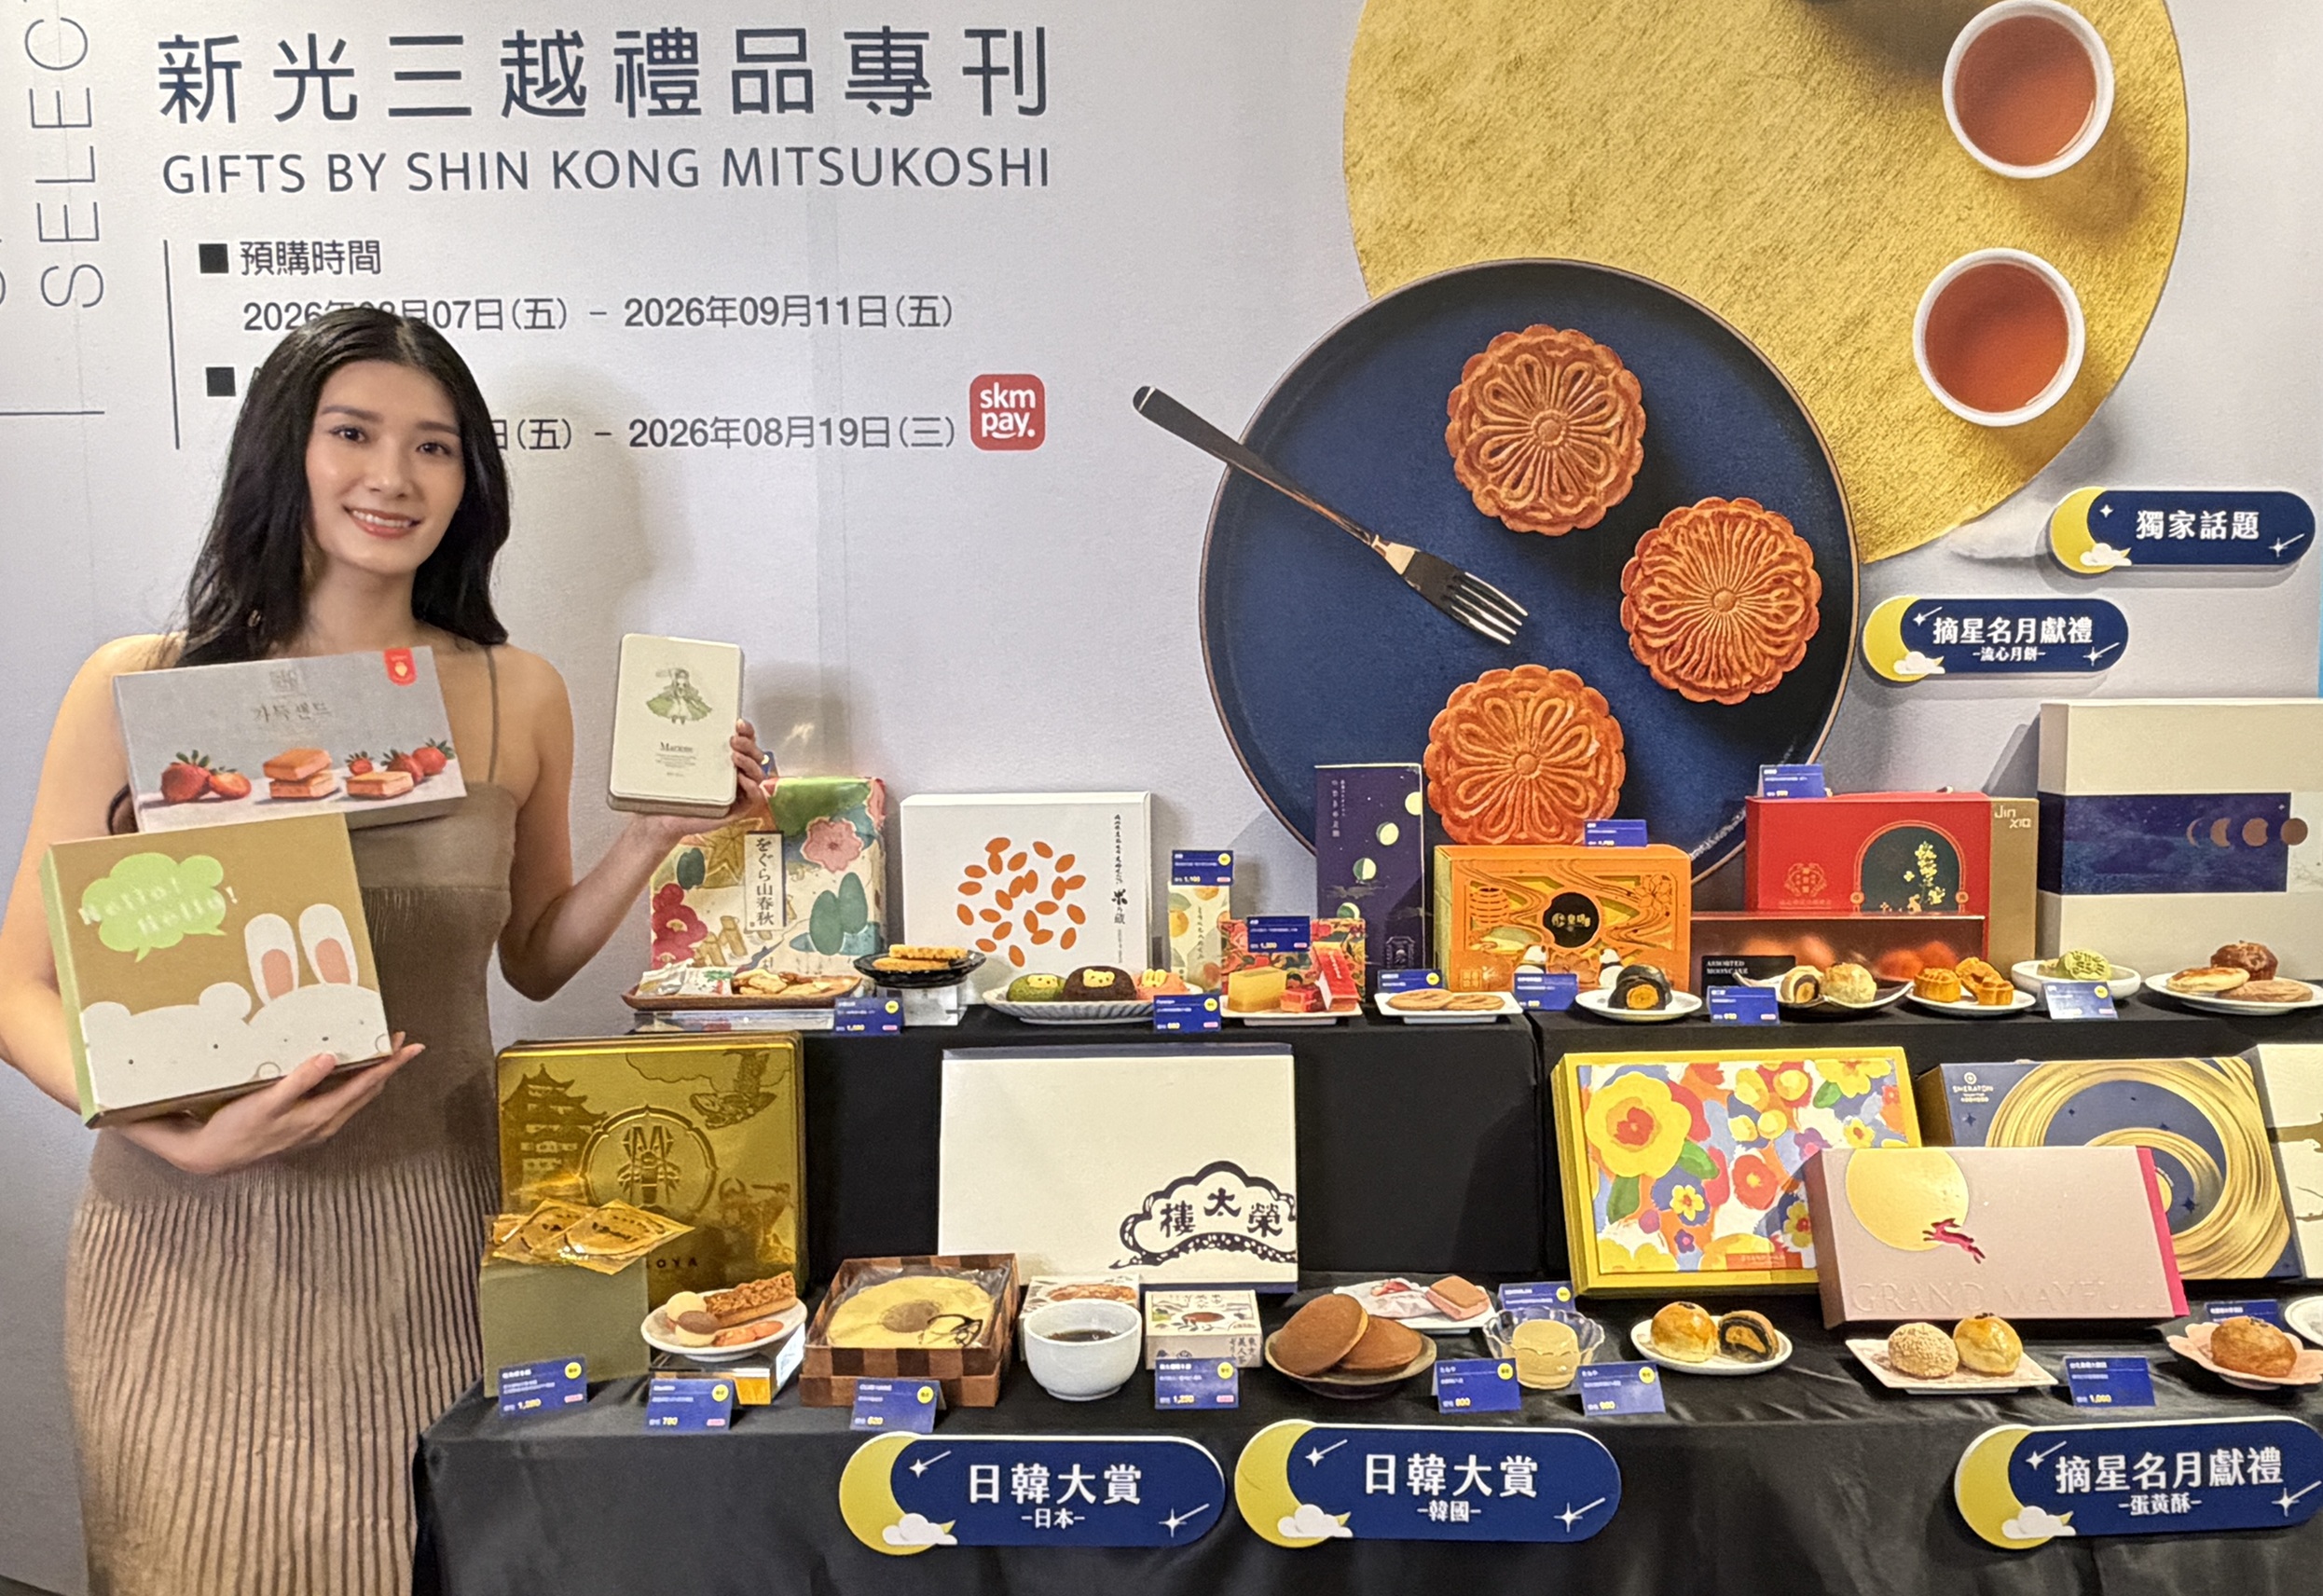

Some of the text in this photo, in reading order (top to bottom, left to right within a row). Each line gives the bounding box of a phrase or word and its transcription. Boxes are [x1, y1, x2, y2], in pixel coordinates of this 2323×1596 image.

[157, 25, 1048, 124] 新光三越禮品專刊
[23, 0, 104, 309] SELEC
[162, 145, 1049, 194] GIFTS BY SHIN KONG MITSUKOSHI
[239, 240, 382, 276] 預購時間
[978, 383, 1037, 410] skm
[981, 411, 1037, 439] pay.
[2136, 509, 2261, 541] 獨家話題
[1932, 615, 2094, 645] 摘星名月獻禮
[755, 836, 776, 927] をぐら山春秋
[646, 1256, 698, 1270] OYA
[1851, 1281, 1986, 1313] GRAND
[969, 1463, 1142, 1506] 日韓大賞
[1366, 1452, 1538, 1498] 日韓大賞
[2055, 1446, 2284, 1494] 摘星名月獻禮
